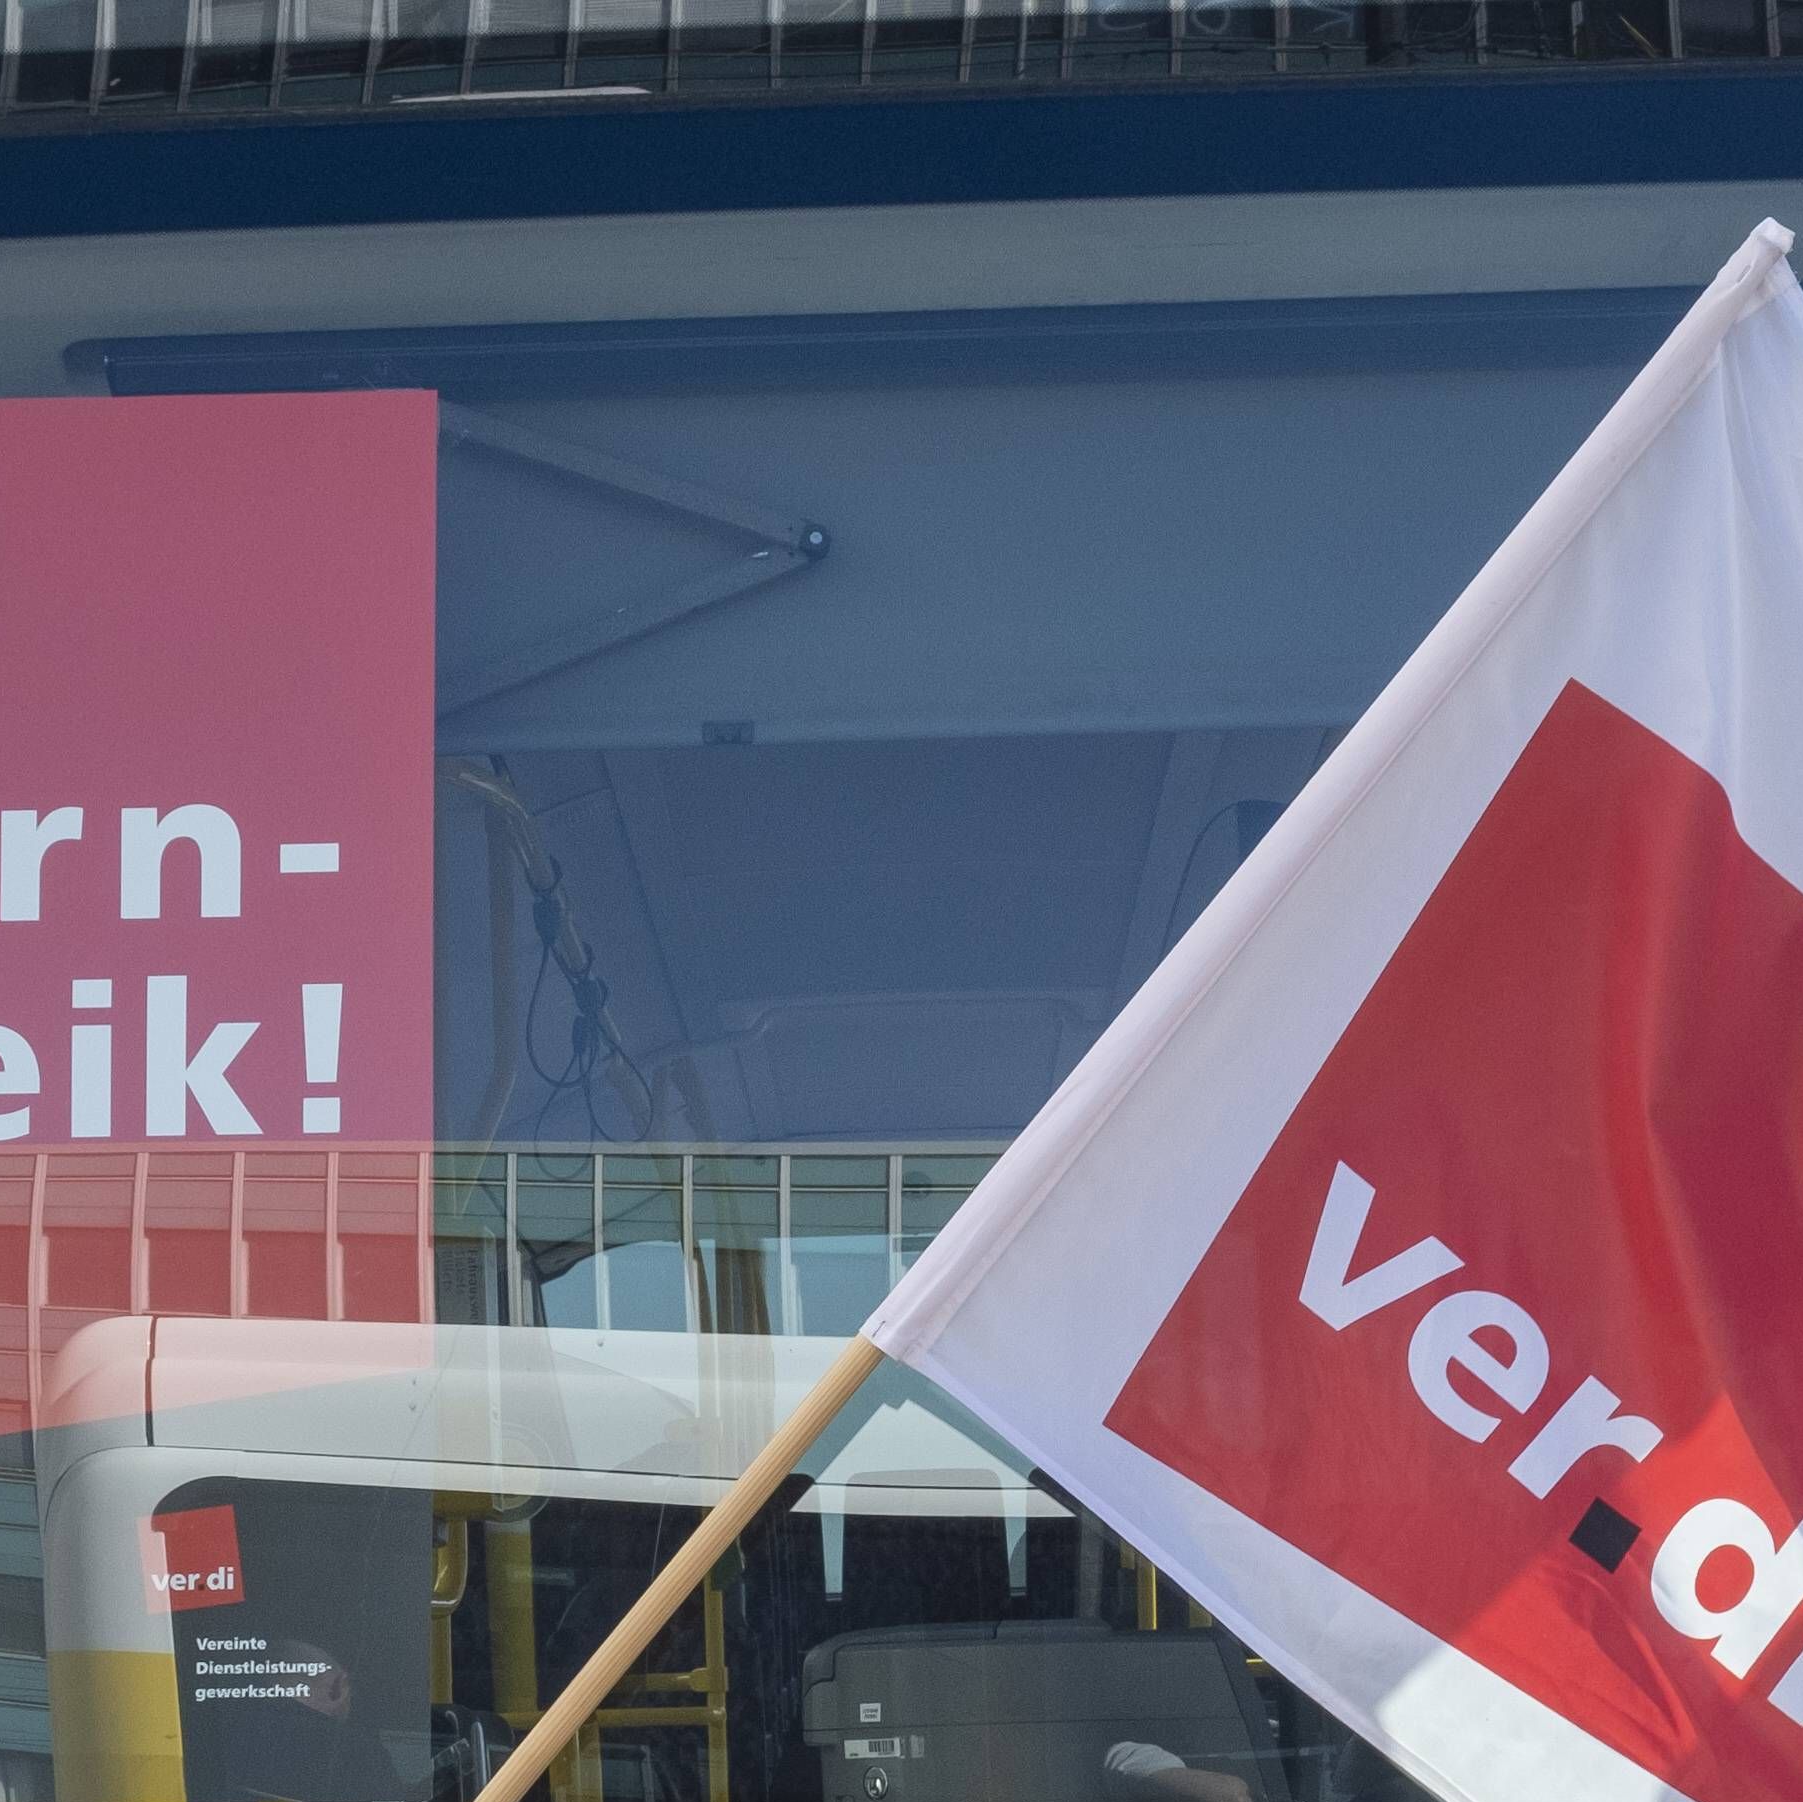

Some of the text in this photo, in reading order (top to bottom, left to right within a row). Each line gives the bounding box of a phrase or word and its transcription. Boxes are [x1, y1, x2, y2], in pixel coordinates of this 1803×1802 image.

[151, 1567, 234, 1592] ver.di
[196, 1637, 267, 1651] Vereinte
[195, 1659, 332, 1677] Dienstleistungs-
[195, 1683, 311, 1701] gewerkschaft
